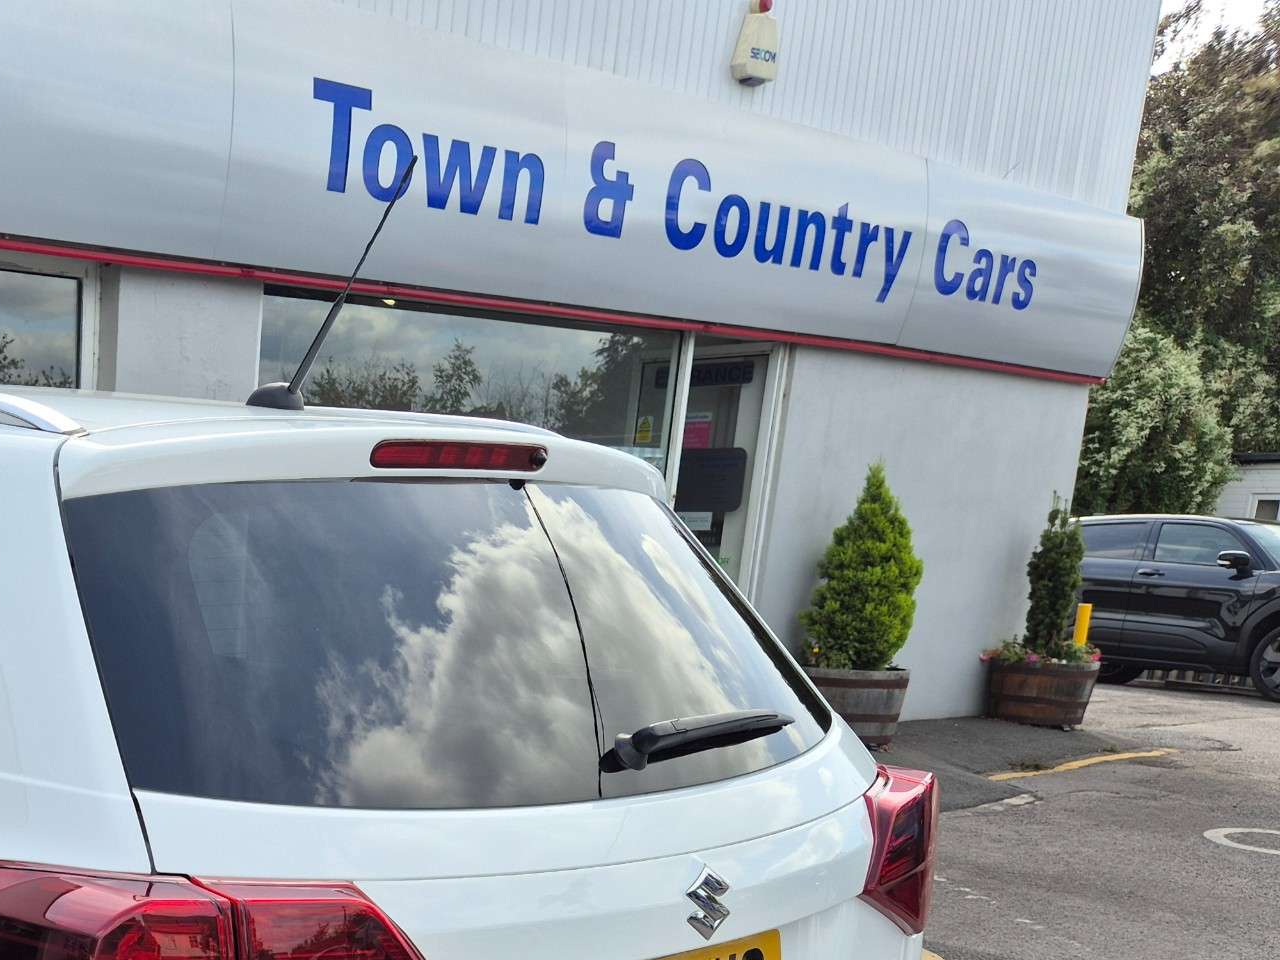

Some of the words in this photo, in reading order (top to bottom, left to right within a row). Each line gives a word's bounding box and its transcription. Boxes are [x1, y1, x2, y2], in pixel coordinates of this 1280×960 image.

[313, 76, 545, 226] Town
[583, 140, 635, 240] &
[664, 158, 914, 304] Country
[932, 218, 1038, 312] Cars
